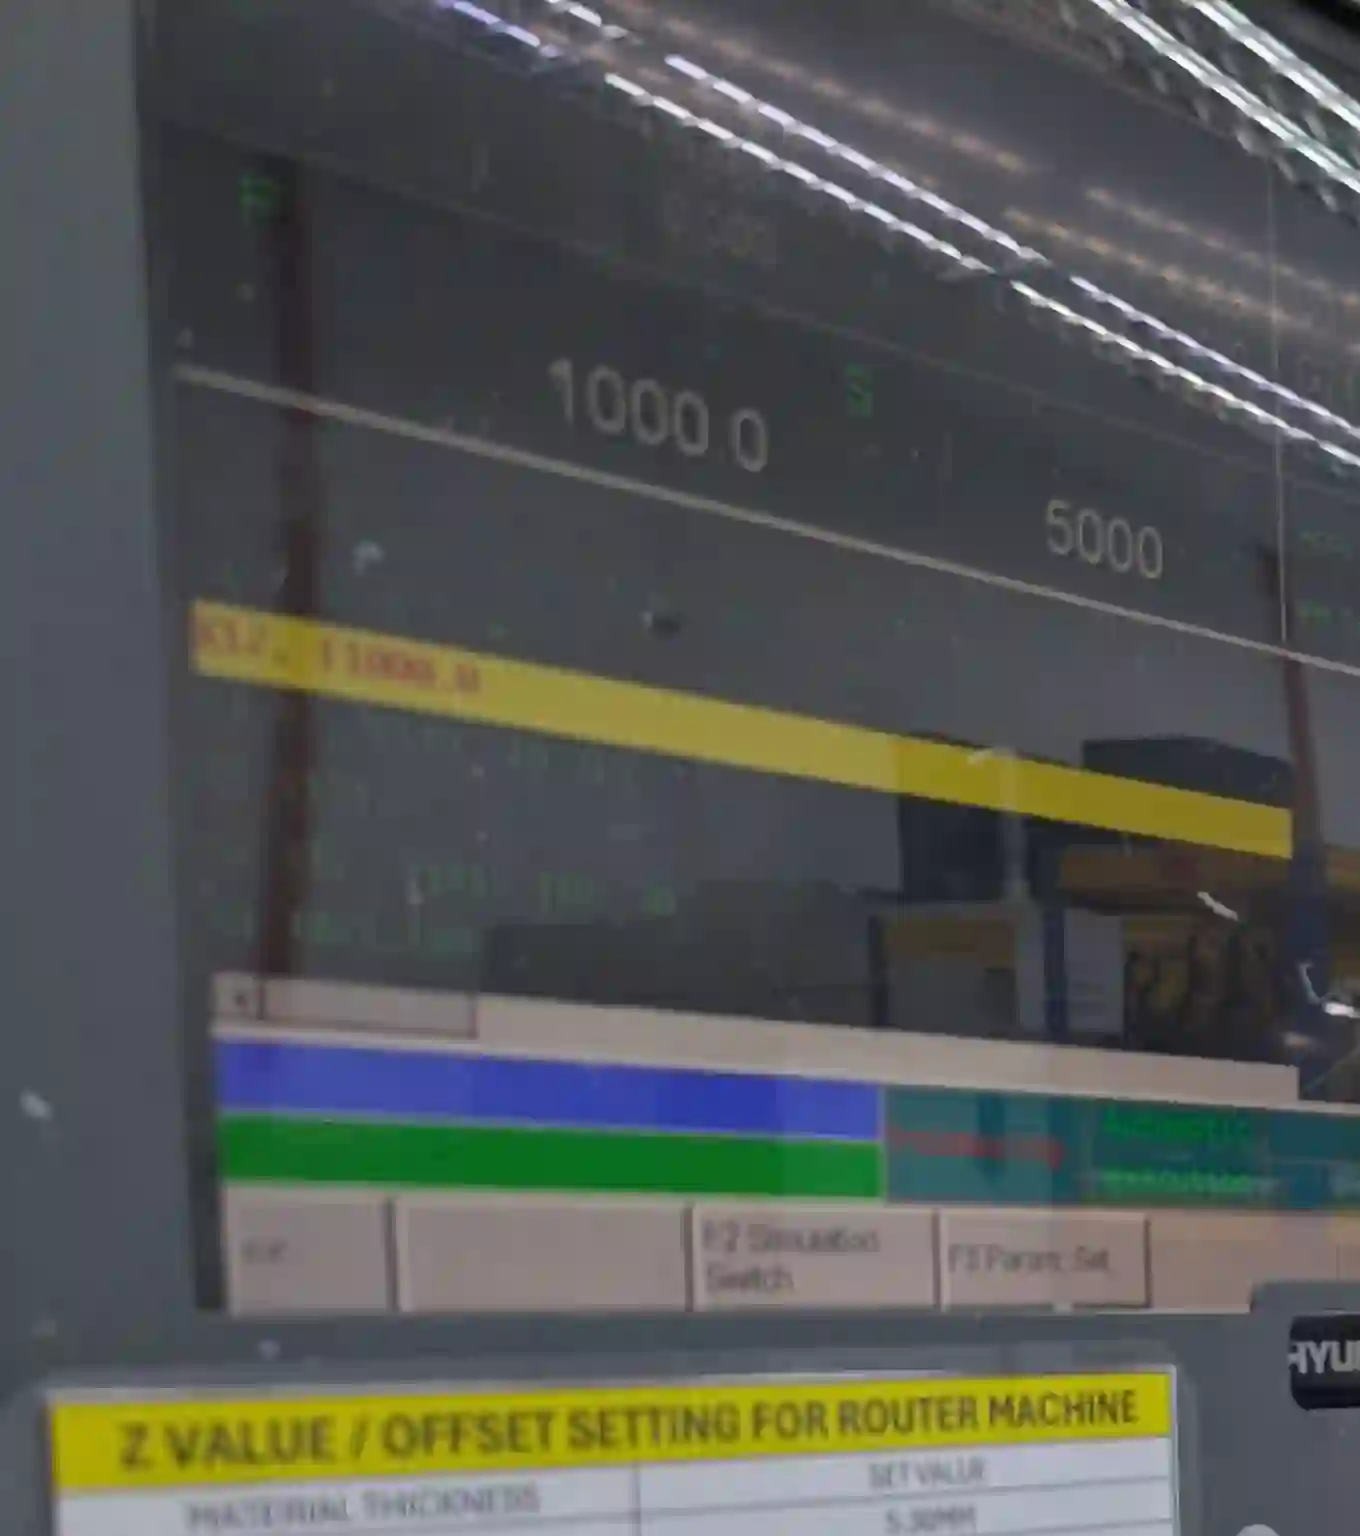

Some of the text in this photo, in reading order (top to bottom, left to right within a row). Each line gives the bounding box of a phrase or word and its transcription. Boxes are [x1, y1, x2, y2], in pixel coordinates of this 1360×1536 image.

[1046, 498, 1163, 579] 5000
[117, 1388, 1139, 1472] Z VALUE / OFFSET SETTING FOR ROUTER MACHINE
[184, 1483, 541, 1533] MATERIAL THICKNESS
